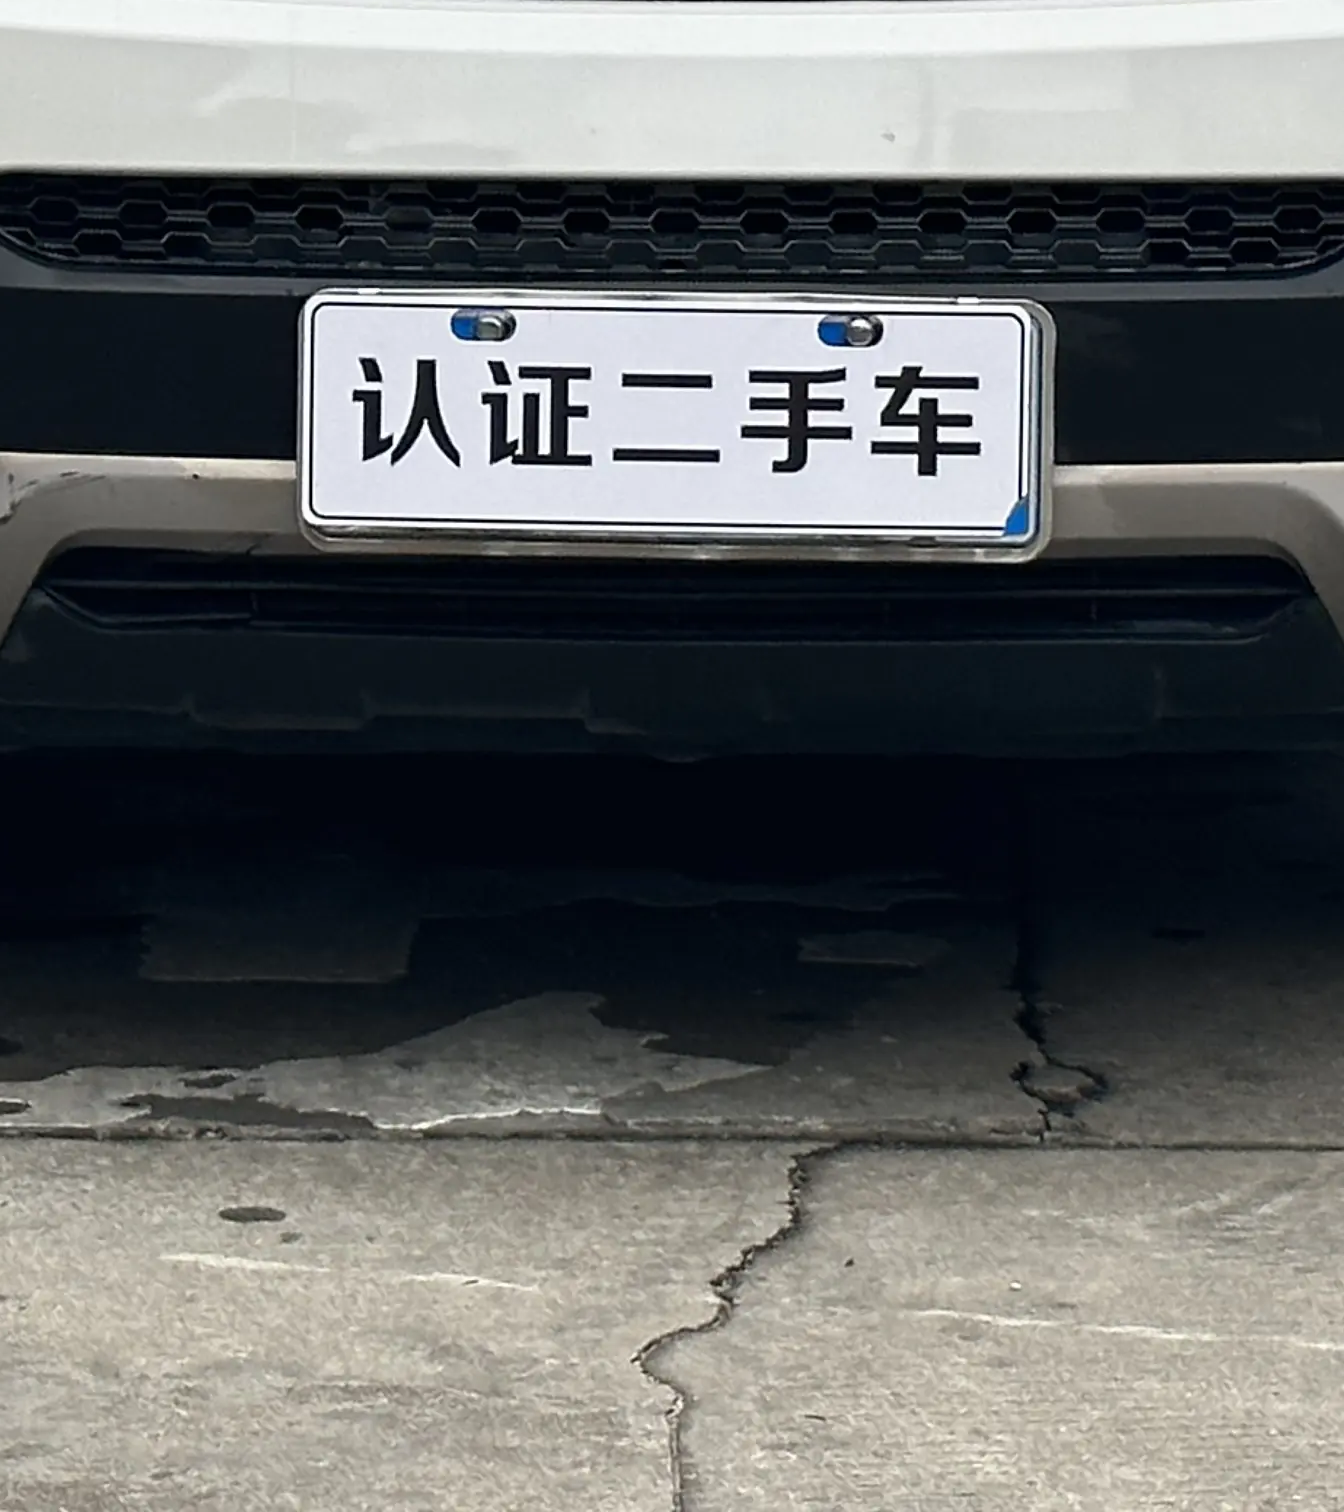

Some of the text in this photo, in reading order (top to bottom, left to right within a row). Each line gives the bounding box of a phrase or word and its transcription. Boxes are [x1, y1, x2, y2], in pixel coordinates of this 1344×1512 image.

[352, 357, 982, 477] 认证二手车
